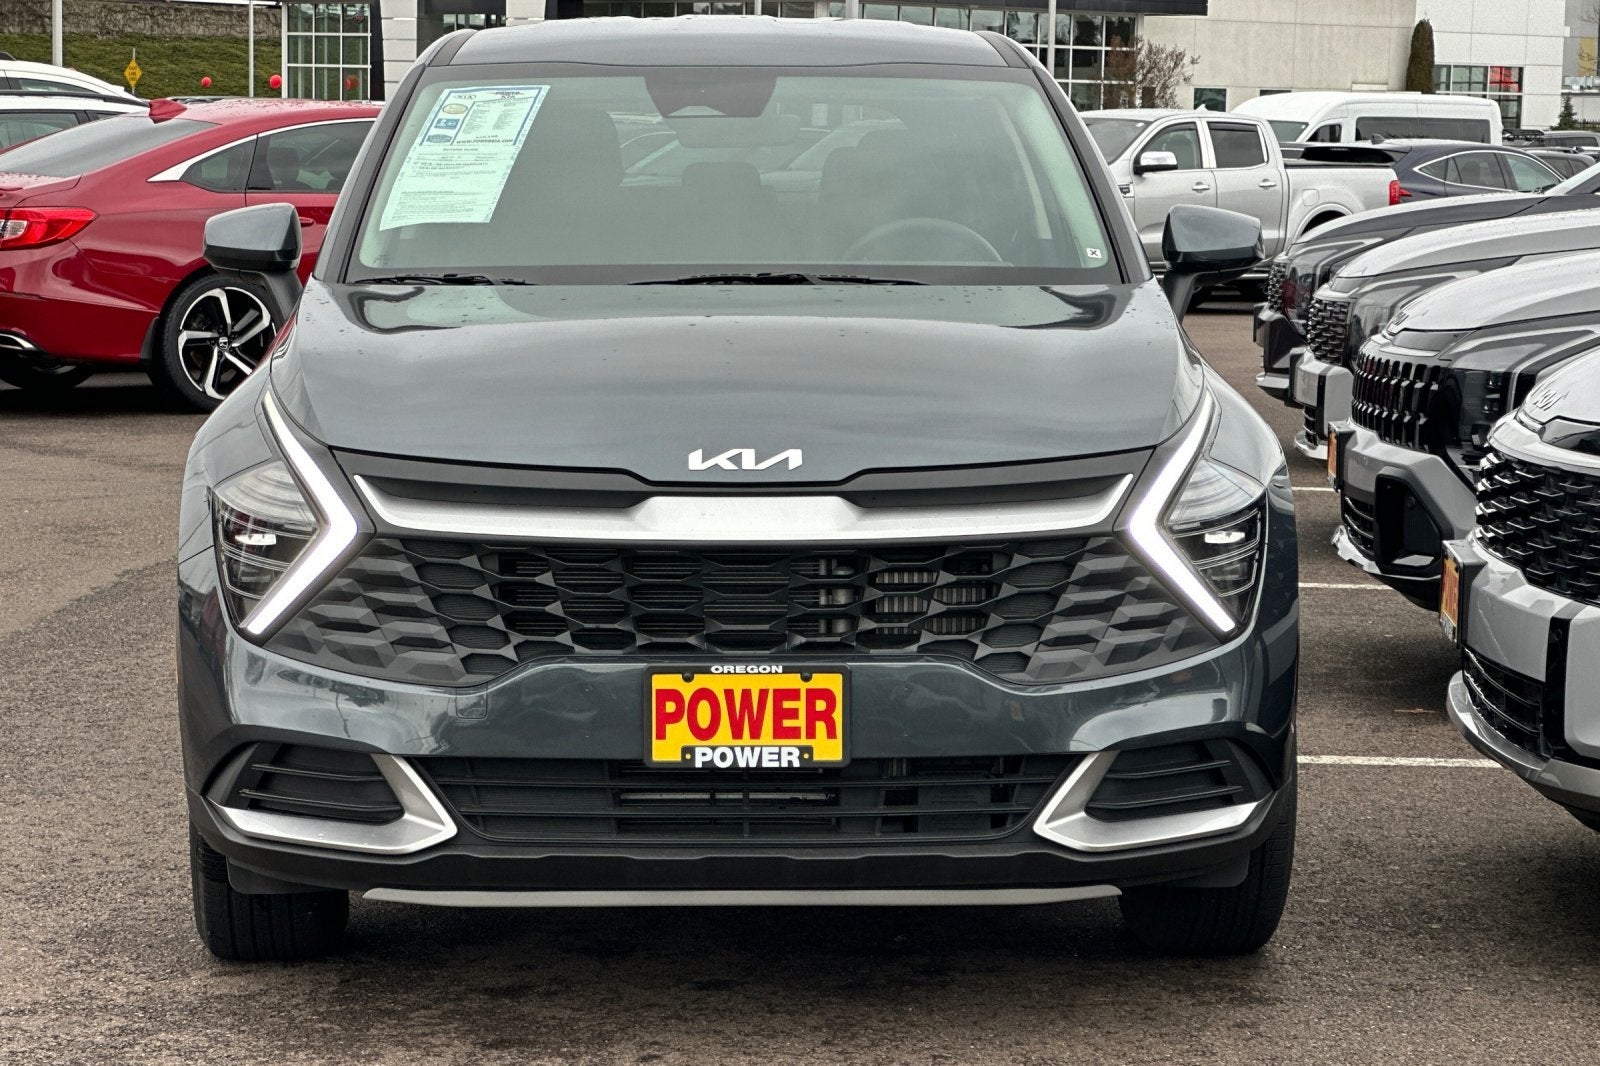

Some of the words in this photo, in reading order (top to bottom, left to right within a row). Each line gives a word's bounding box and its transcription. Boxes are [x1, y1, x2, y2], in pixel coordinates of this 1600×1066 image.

[688, 448, 803, 470] KIA
[710, 665, 783, 674] OREGON
[654, 687, 838, 742] POWER
[694, 746, 801, 769] POWER
